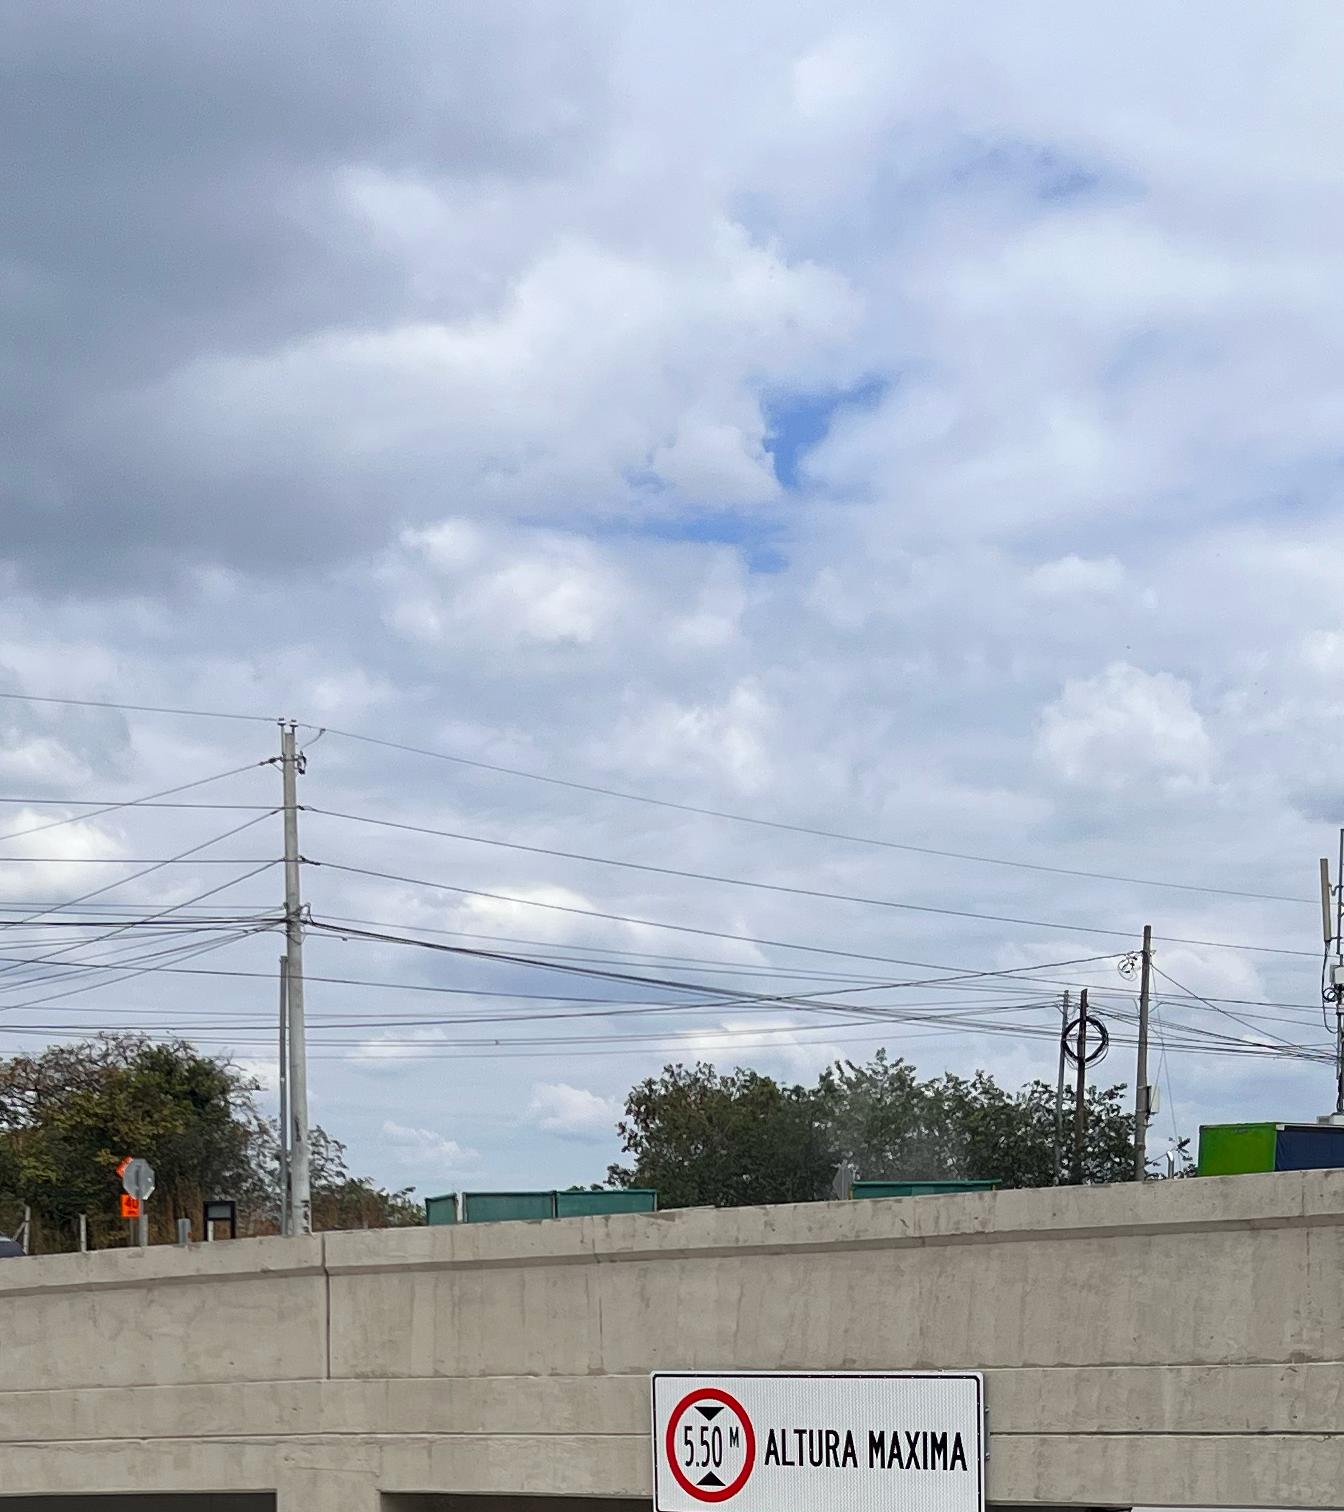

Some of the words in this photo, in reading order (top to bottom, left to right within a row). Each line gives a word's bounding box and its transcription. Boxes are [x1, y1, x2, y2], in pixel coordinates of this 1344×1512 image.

[683, 1425, 723, 1468] 5.50
[729, 1426, 740, 1448] M
[764, 1428, 858, 1468] ALTURA
[868, 1430, 968, 1471] MAXIMA
